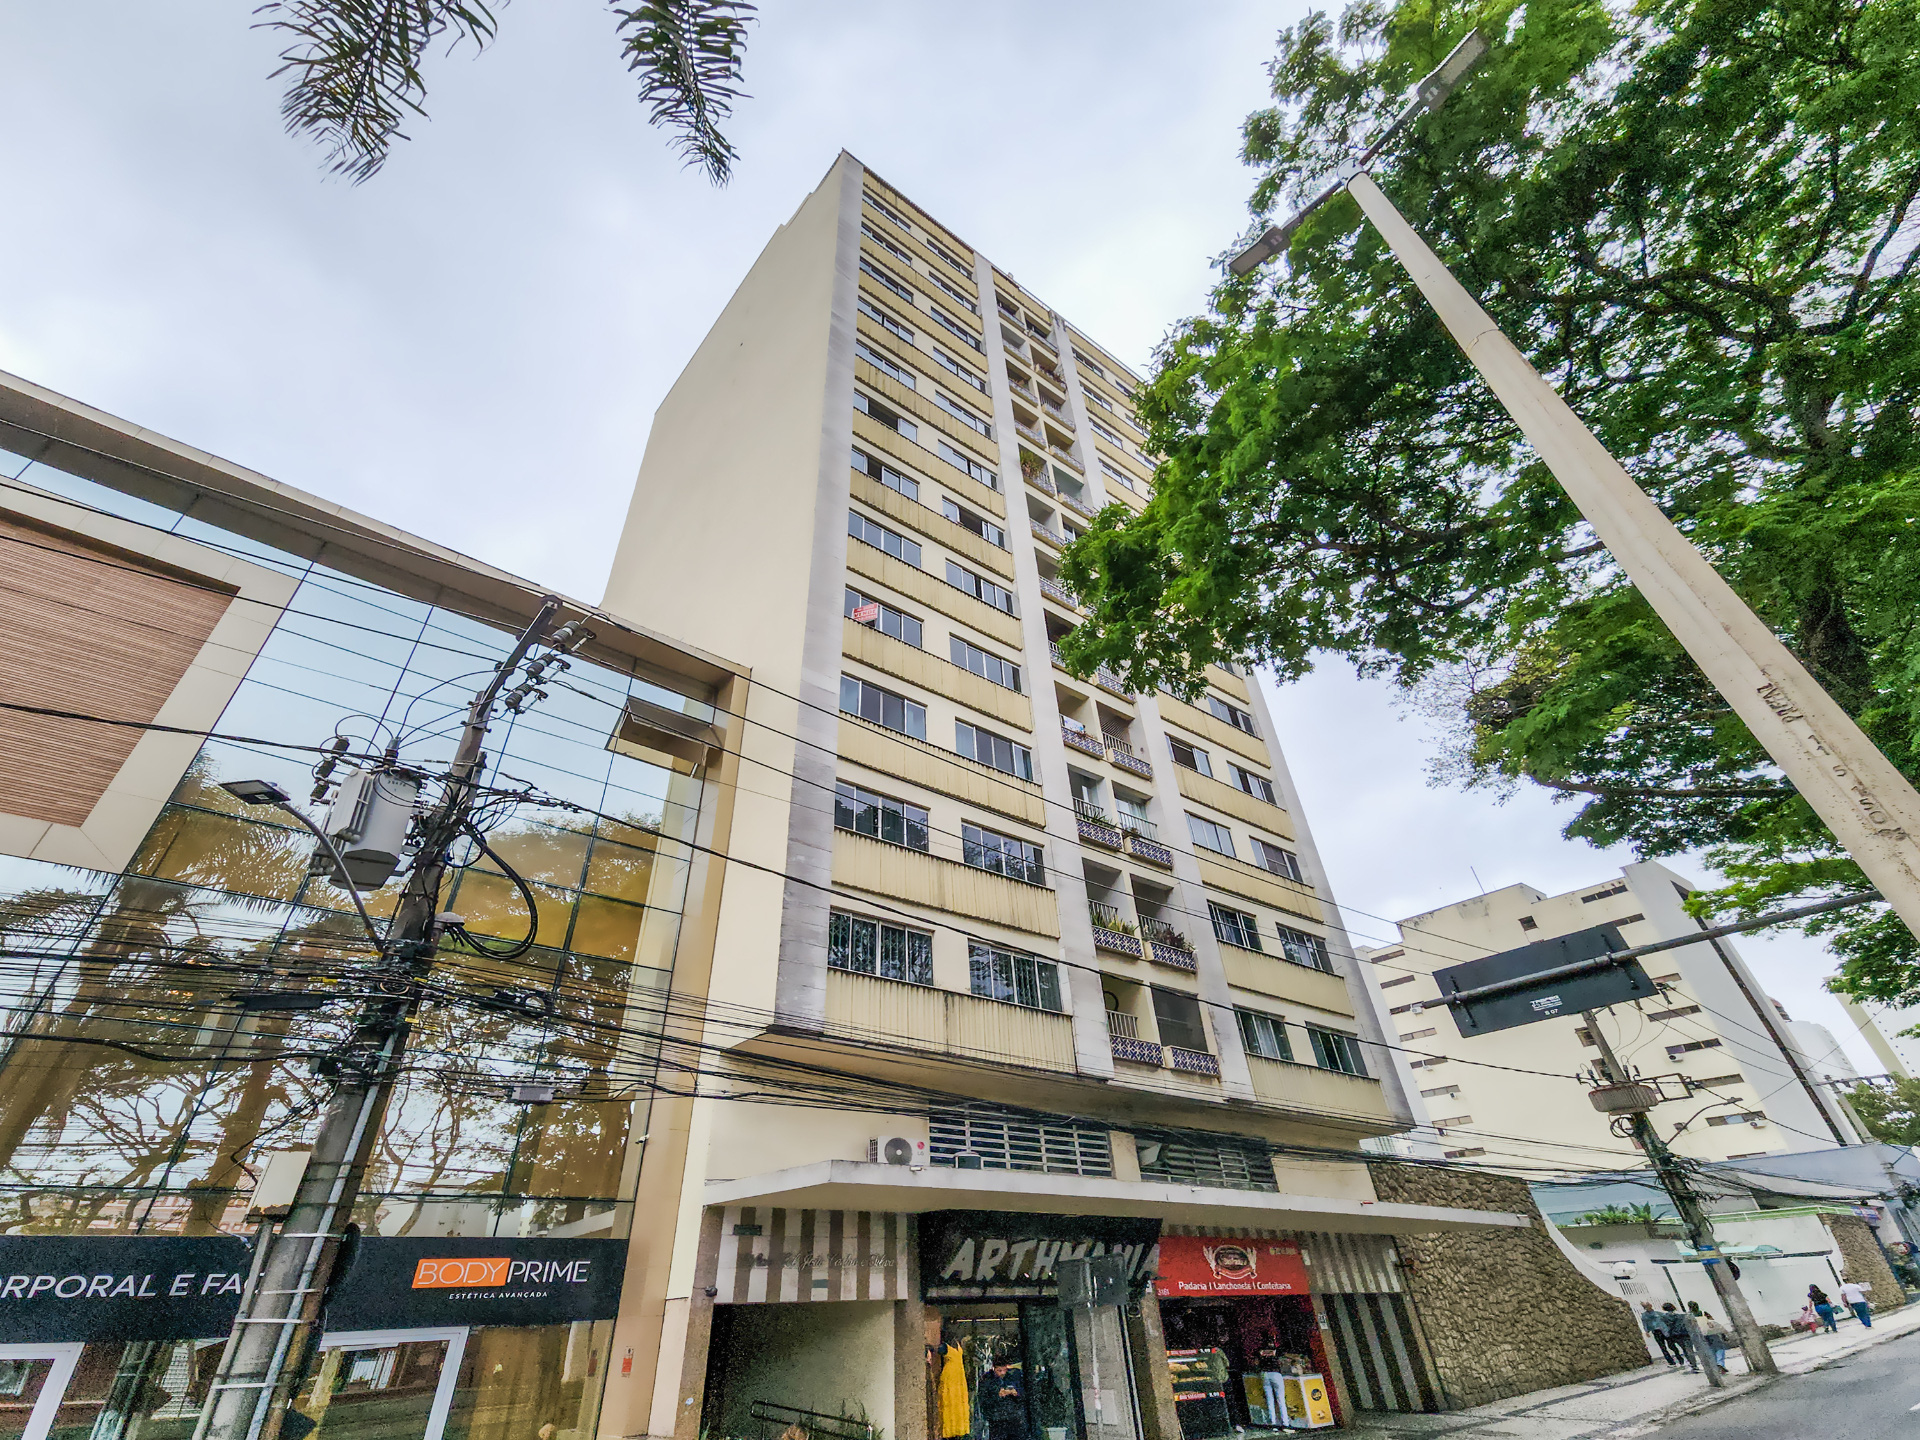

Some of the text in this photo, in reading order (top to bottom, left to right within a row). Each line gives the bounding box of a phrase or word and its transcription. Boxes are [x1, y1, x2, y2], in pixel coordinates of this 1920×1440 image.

[417, 1261, 591, 1285] BODY PRIME
[0, 1275, 157, 1299] RPORAL
[169, 1274, 196, 1297] E
[1178, 1281, 1208, 1291] Padaria
[1213, 1281, 1252, 1290] Lanchonete
[1256, 1281, 1292, 1290] Confeitaria
[449, 1291, 548, 1300] ESTÉTICA AVANÇADA
